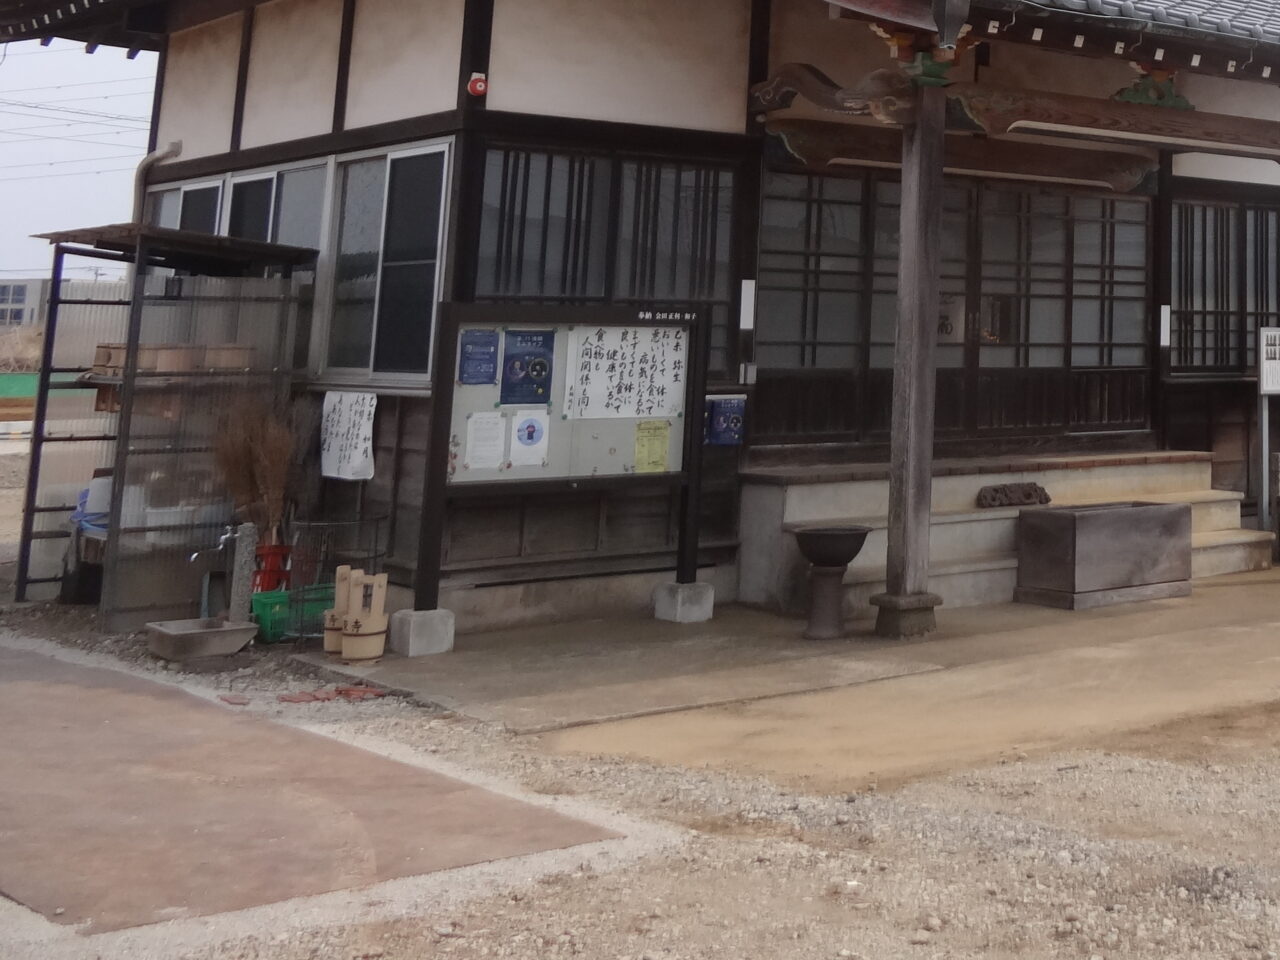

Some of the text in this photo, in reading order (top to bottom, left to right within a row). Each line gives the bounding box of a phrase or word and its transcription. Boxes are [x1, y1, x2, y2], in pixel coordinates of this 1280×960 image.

[594, 327, 607, 371] 食べ物も
[635, 351, 649, 416] 病気になるか
